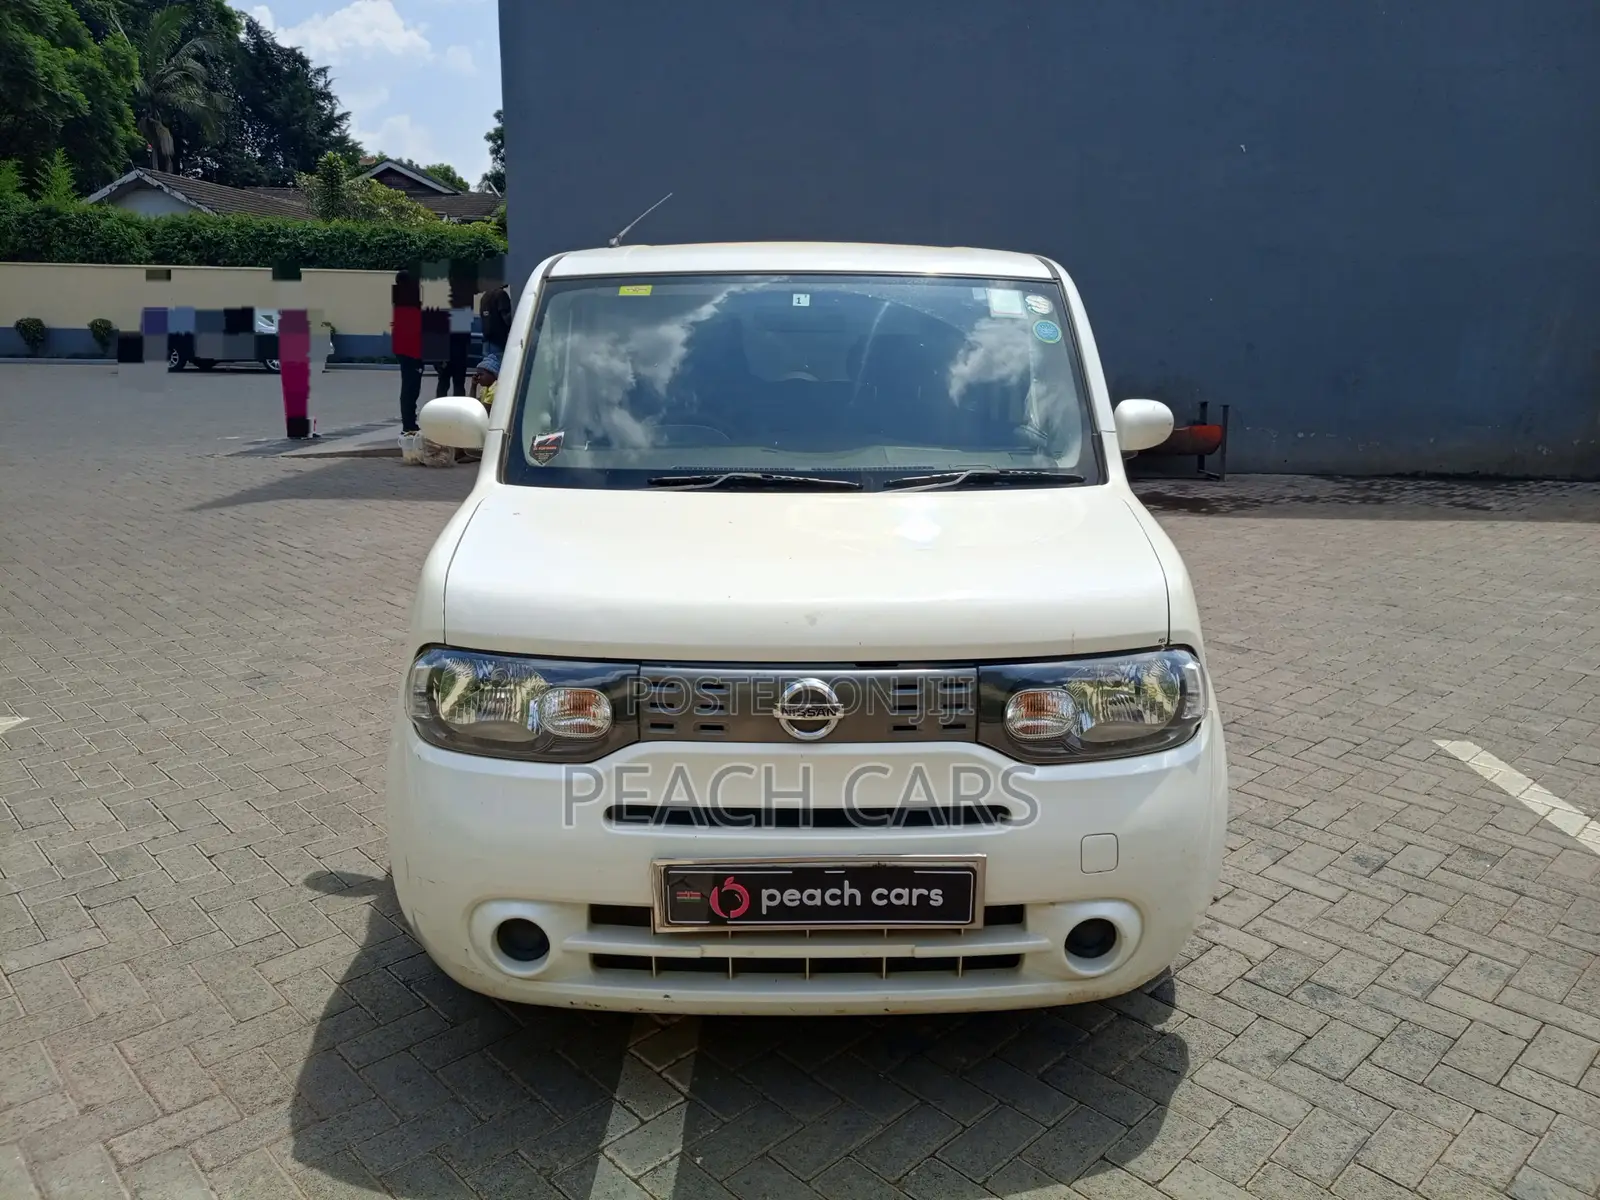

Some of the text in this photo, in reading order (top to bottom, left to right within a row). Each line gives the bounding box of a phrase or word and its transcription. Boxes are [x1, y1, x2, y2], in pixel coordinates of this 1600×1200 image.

[781, 708, 837, 718] NISSAN
[761, 880, 944, 915] peach cars
